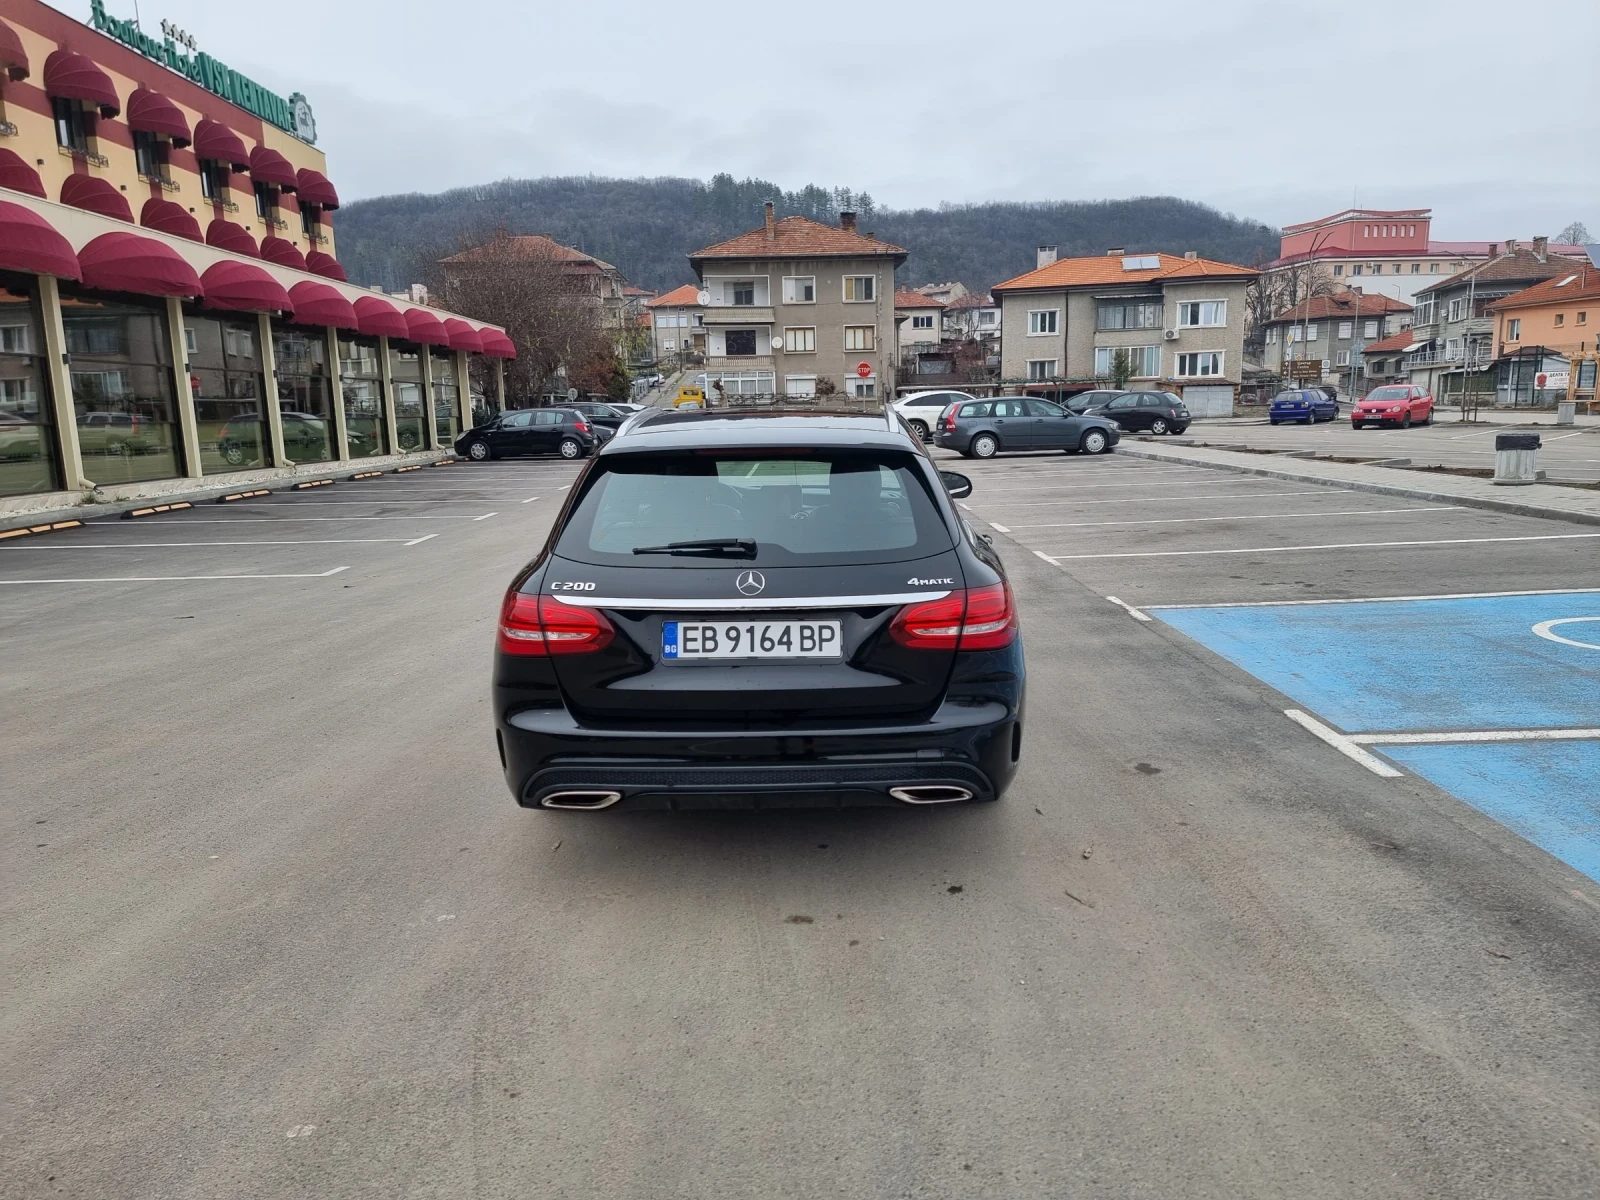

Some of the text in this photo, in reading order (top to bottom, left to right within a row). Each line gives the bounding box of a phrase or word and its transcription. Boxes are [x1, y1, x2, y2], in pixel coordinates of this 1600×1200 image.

[198, 52, 232, 101] VSK
[551, 581, 596, 591] C 200
[907, 577, 955, 586] 4MATIC
[682, 625, 836, 654] EB 9164 BP
[664, 644, 677, 654] BG
